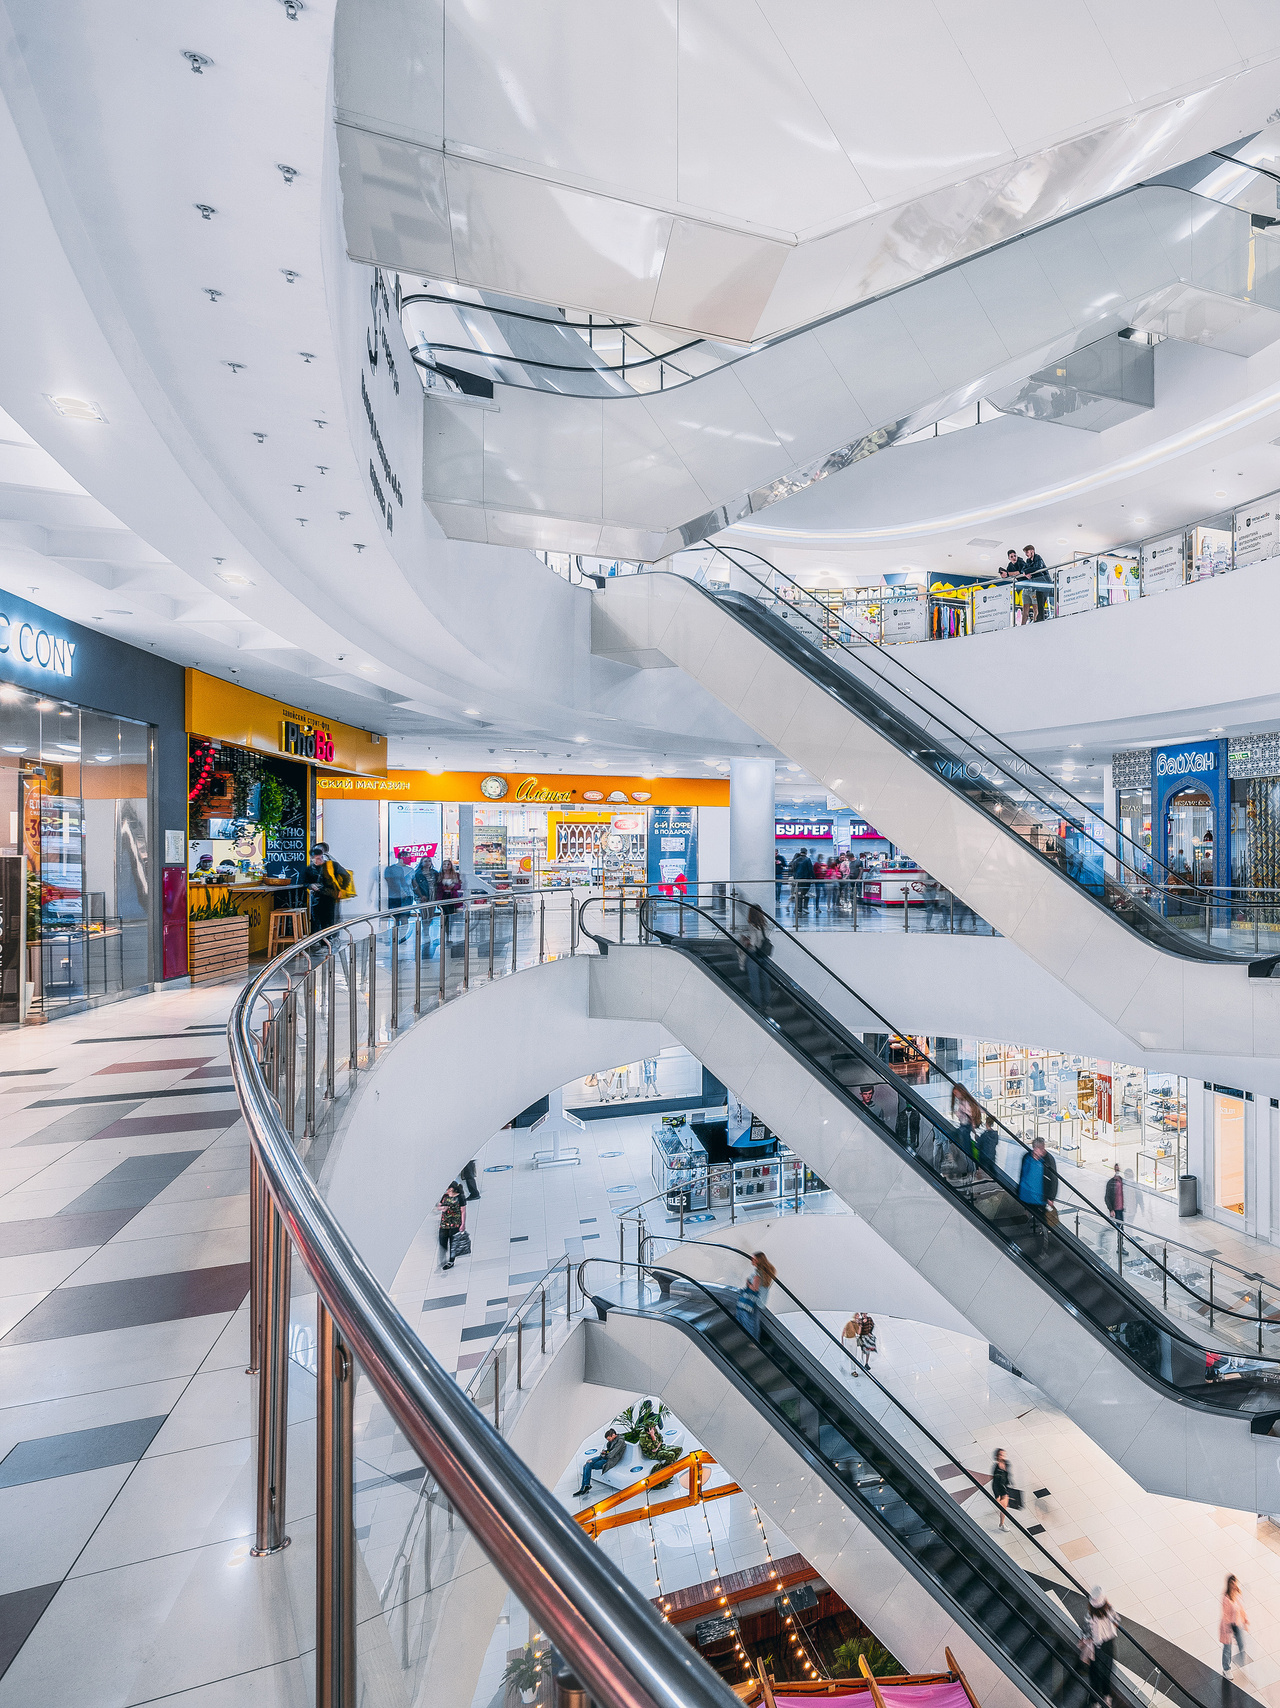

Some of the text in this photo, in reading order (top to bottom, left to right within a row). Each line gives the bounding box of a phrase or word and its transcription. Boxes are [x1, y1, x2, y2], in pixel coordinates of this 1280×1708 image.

[18, 622, 77, 678] CONY
[356, 780, 410, 790] МАГАЗИН
[654, 821, 668, 829] 6-Й
[776, 824, 829, 836] БУРГЕР
[398, 844, 433, 853] ТОВАР
